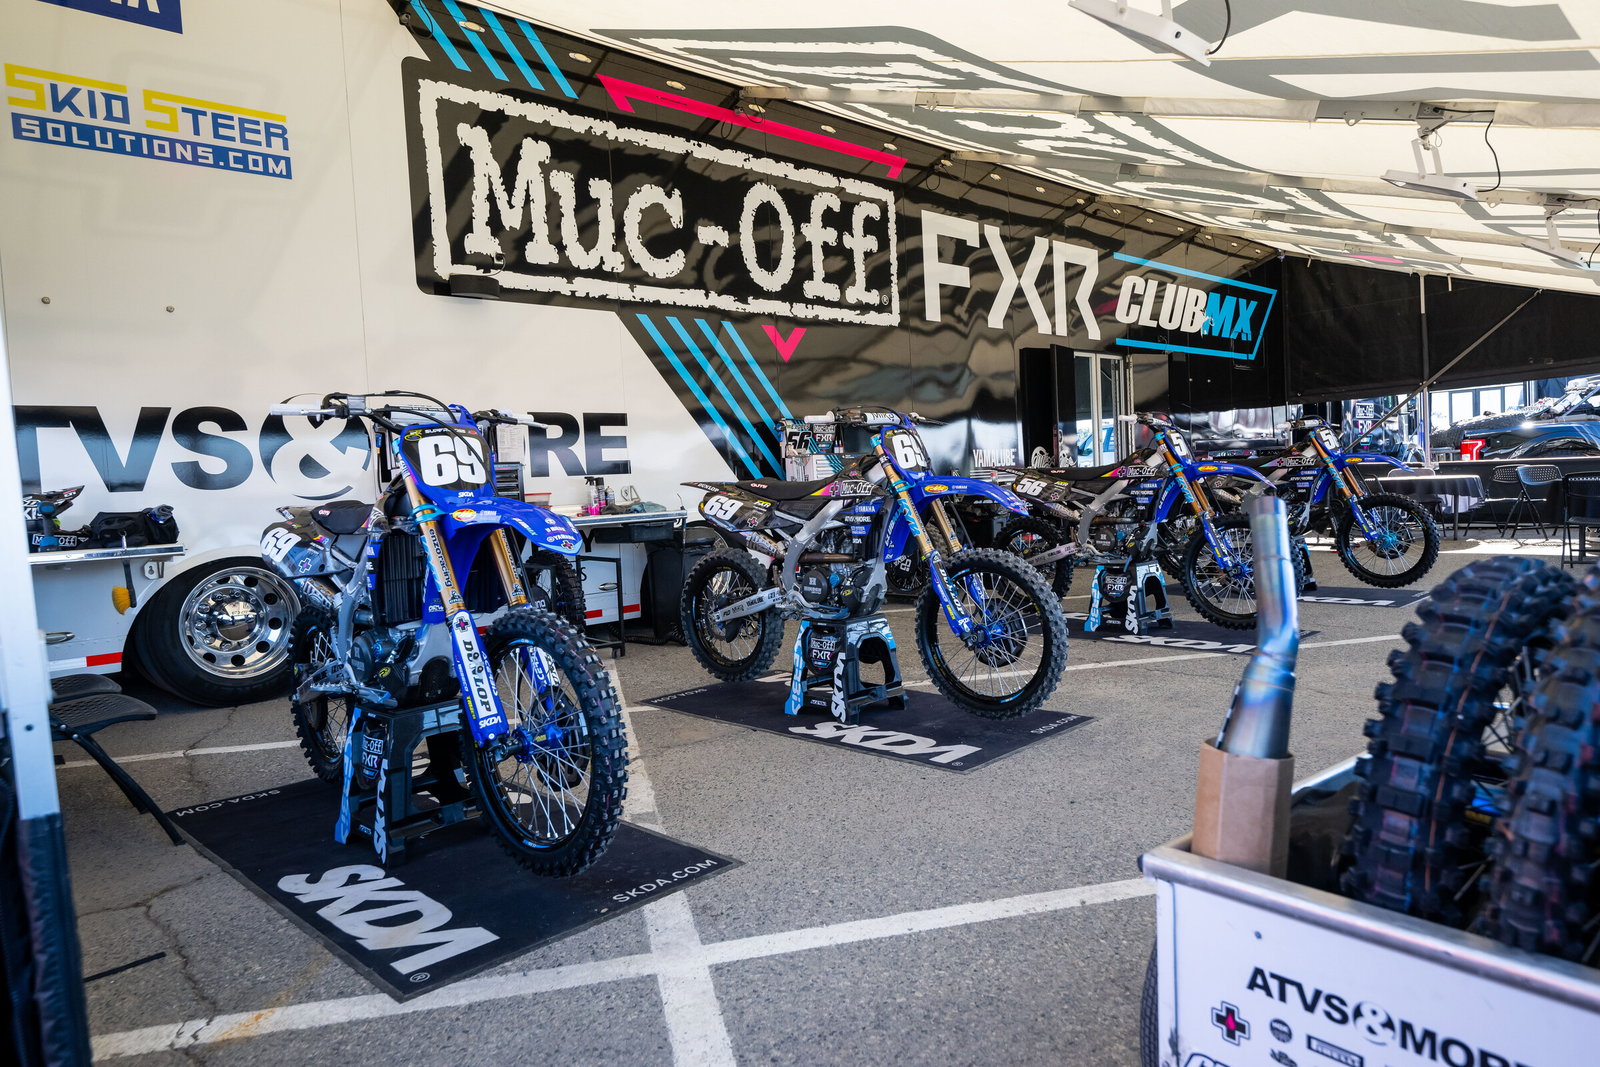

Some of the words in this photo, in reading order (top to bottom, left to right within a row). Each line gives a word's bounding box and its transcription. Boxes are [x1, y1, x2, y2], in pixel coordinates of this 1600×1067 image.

[4, 63, 131, 125] SKID
[142, 89, 290, 151] STEER
[20, 118, 288, 177] SOLUTIONS.COM
[456, 122, 881, 304] Muc-Off
[921, 209, 1101, 342] FXR
[787, 431, 812, 450] 56
[815, 433, 833, 442] FXR
[972, 447, 1017, 468] YAMALUBE
[418, 435, 487, 487] 69
[704, 495, 744, 521] 69
[1016, 478, 1047, 496] 56
[260, 527, 302, 563] 69
[429, 528, 442, 554] enzo
[438, 555, 453, 587] racing
[812, 650, 831, 660] FXR
[830, 652, 847, 723] SKDA
[478, 716, 502, 729] SKDA
[788, 720, 983, 764] SKDA
[176, 789, 281, 817] SKDA.COM
[612, 859, 718, 903] SKDA.COM
[277, 864, 500, 975] SKDA
